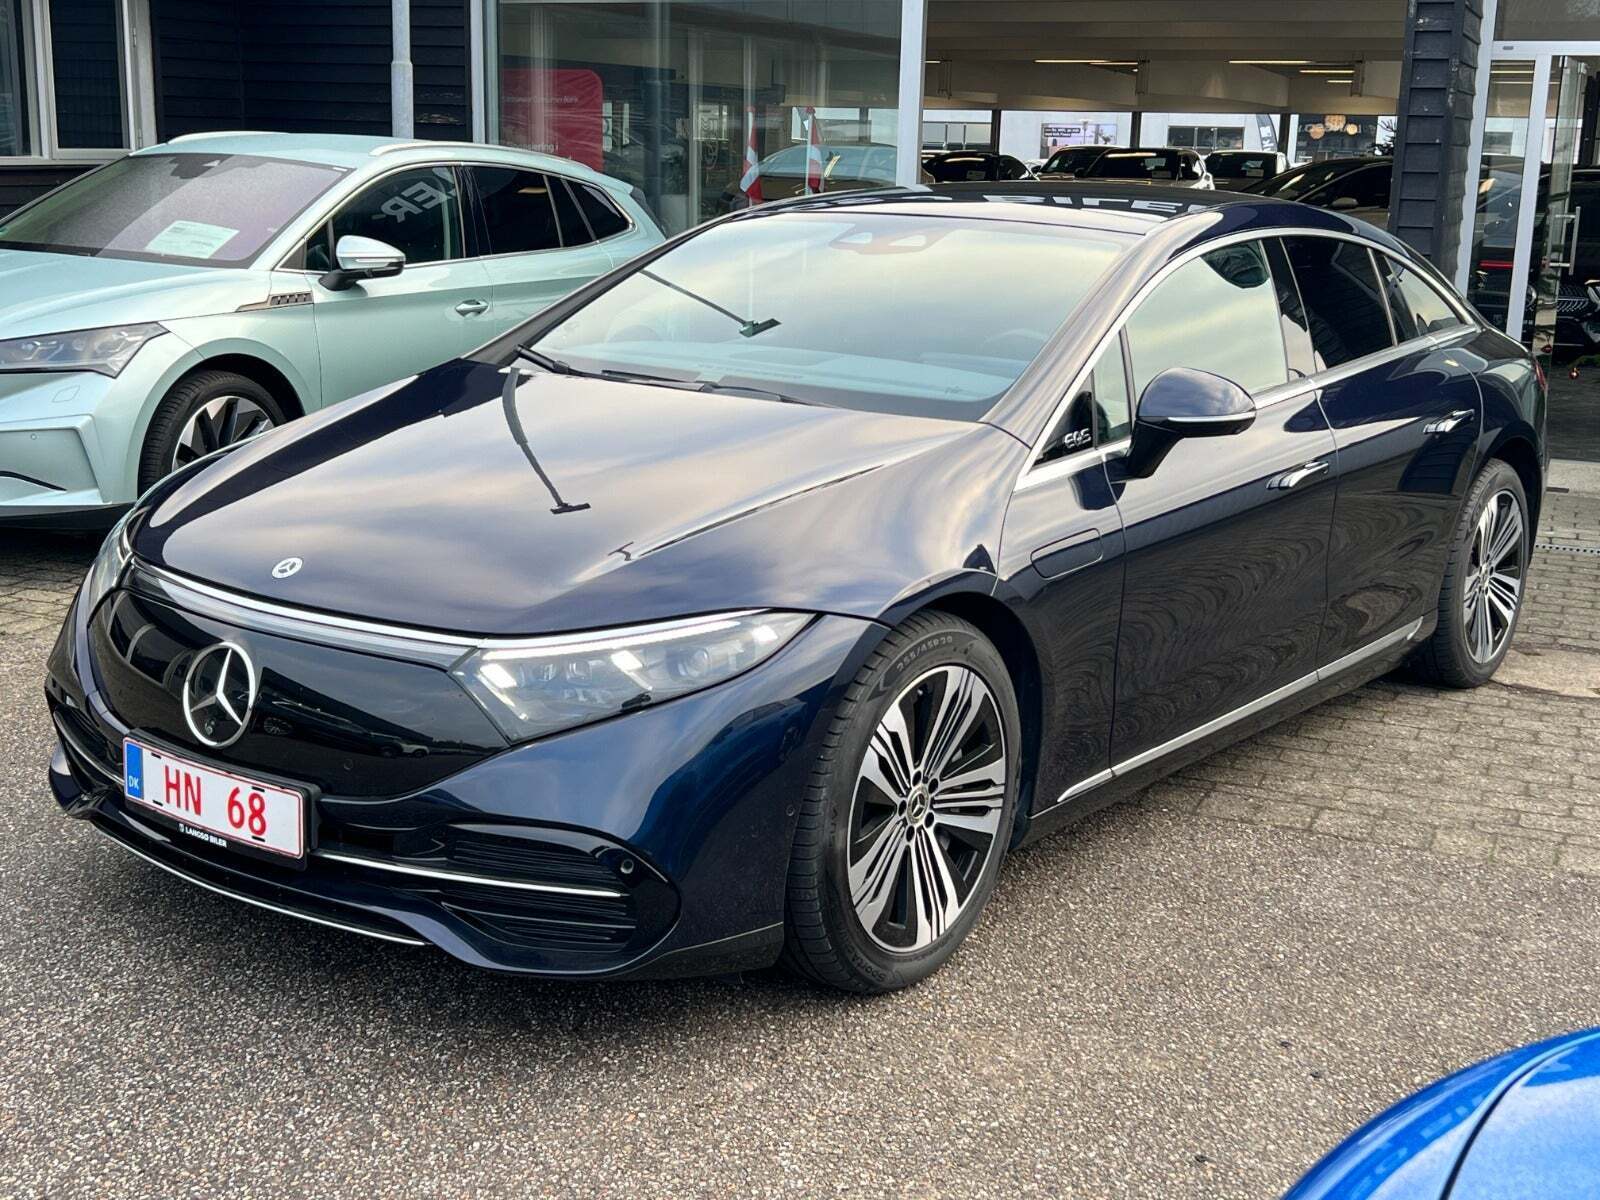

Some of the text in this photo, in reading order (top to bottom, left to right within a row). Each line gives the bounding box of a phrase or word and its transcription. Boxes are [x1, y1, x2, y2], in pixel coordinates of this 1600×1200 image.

[1064, 428, 1092, 449] EQS
[128, 775, 139, 790] DK
[165, 765, 267, 836] HN 68
